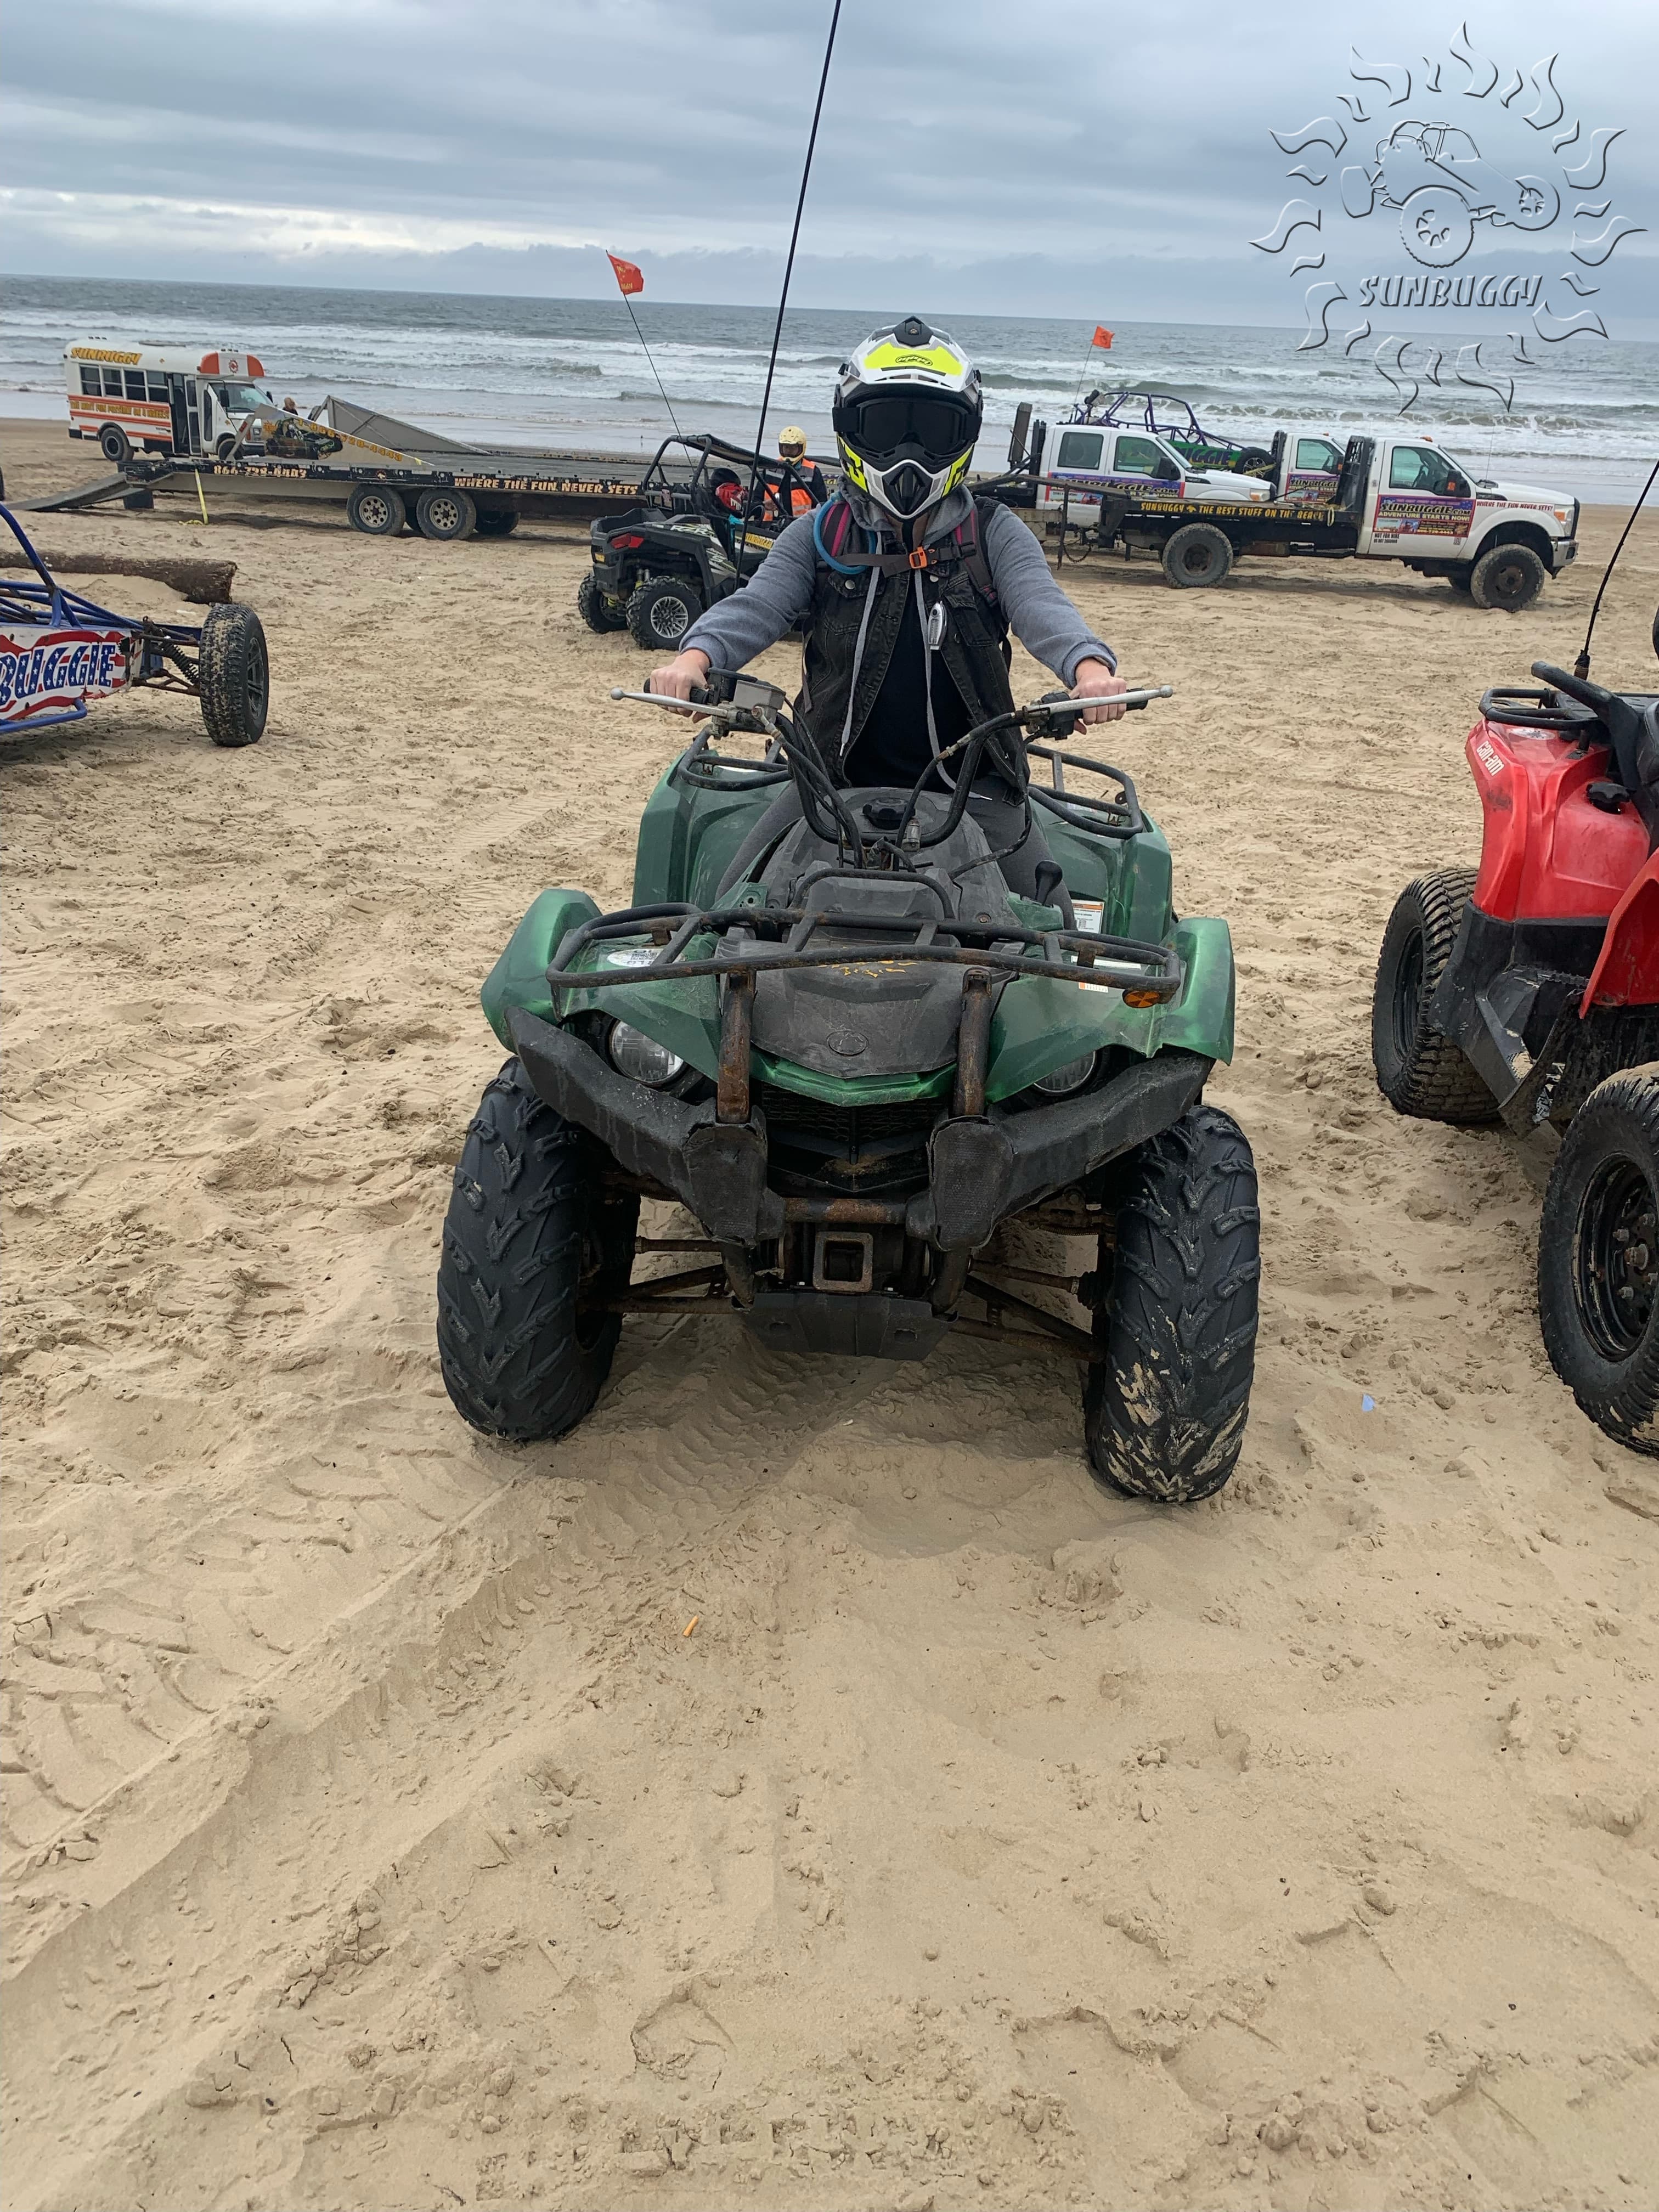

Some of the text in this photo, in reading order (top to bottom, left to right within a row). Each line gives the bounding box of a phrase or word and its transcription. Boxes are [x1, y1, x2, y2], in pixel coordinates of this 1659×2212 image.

[70, 347, 143, 365] SUNBUGGY
[454, 478, 639, 495] WHERE THE FUN NEVER SETS
[1141, 502, 1183, 513] SUNBUGGY
[1199, 506, 1214, 514] THE
[1216, 506, 1236, 515] BEST
[1239, 507, 1262, 516] STUFF
[1265, 509, 1277, 517] ON
[1380, 503, 1471, 516] SUNBUGGIE.COM
[670, 524, 708, 535] RZR
